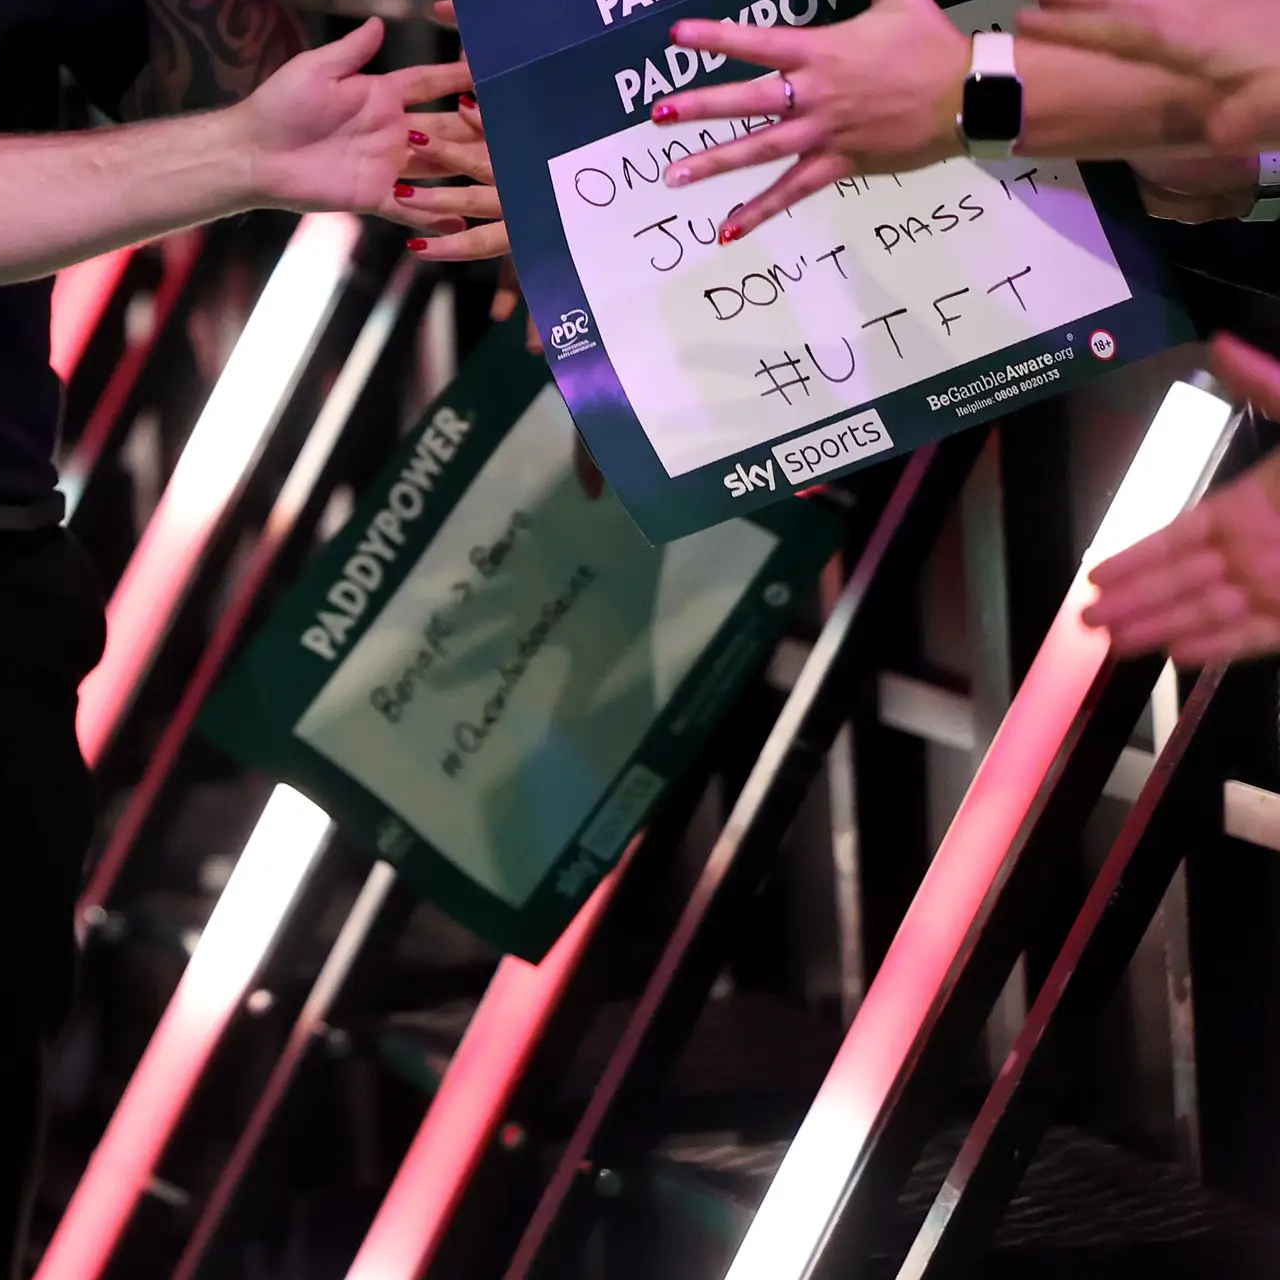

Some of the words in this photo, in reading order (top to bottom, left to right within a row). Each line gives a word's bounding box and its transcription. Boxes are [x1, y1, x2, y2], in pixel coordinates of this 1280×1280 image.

[633, 202, 792, 271] JU
[703, 244, 848, 321] DON'T
[874, 194, 984, 255] PASS
[551, 315, 589, 344] PDC
[1093, 338, 1112, 352] 18+
[926, 345, 1075, 411] BeGambleAware.org
[955, 396, 996, 418] Helpline:
[995, 384, 1020, 403] 0808
[1019, 368, 1061, 393] 8020133
[723, 459, 776, 498] sky
[784, 422, 882, 474] sports
